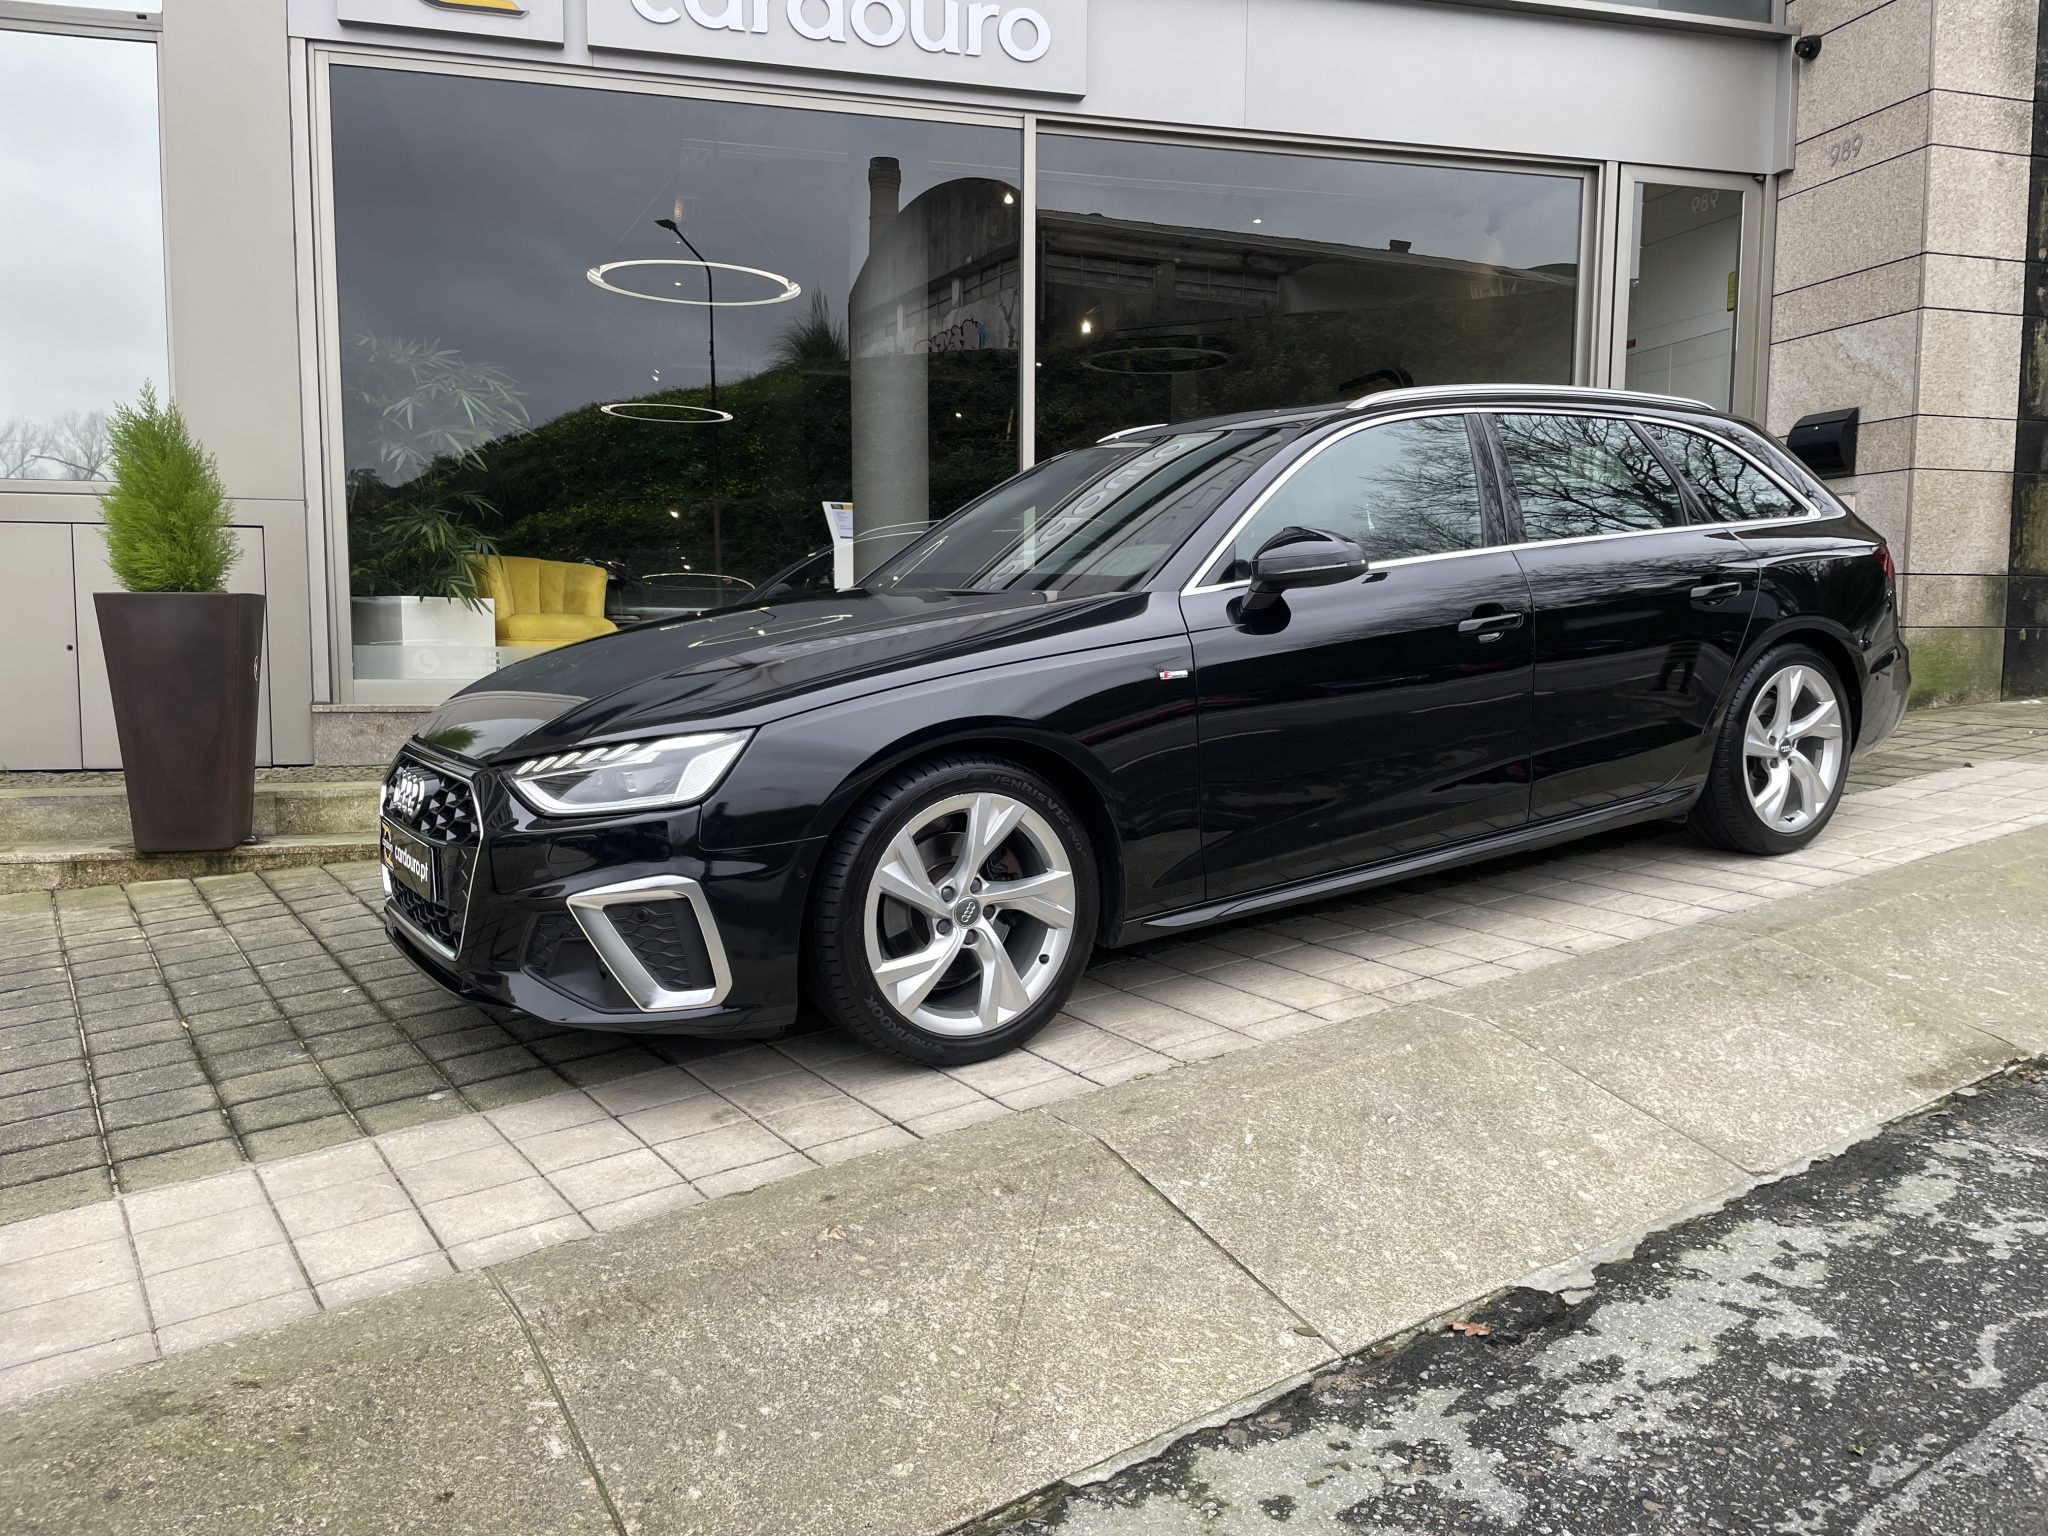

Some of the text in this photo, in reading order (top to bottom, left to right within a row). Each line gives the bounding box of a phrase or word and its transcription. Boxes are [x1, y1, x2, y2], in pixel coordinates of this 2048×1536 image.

[1828, 133, 1864, 168] 989
[1047, 796, 1072, 826] V12
[394, 845, 429, 882] cardouro.pt
